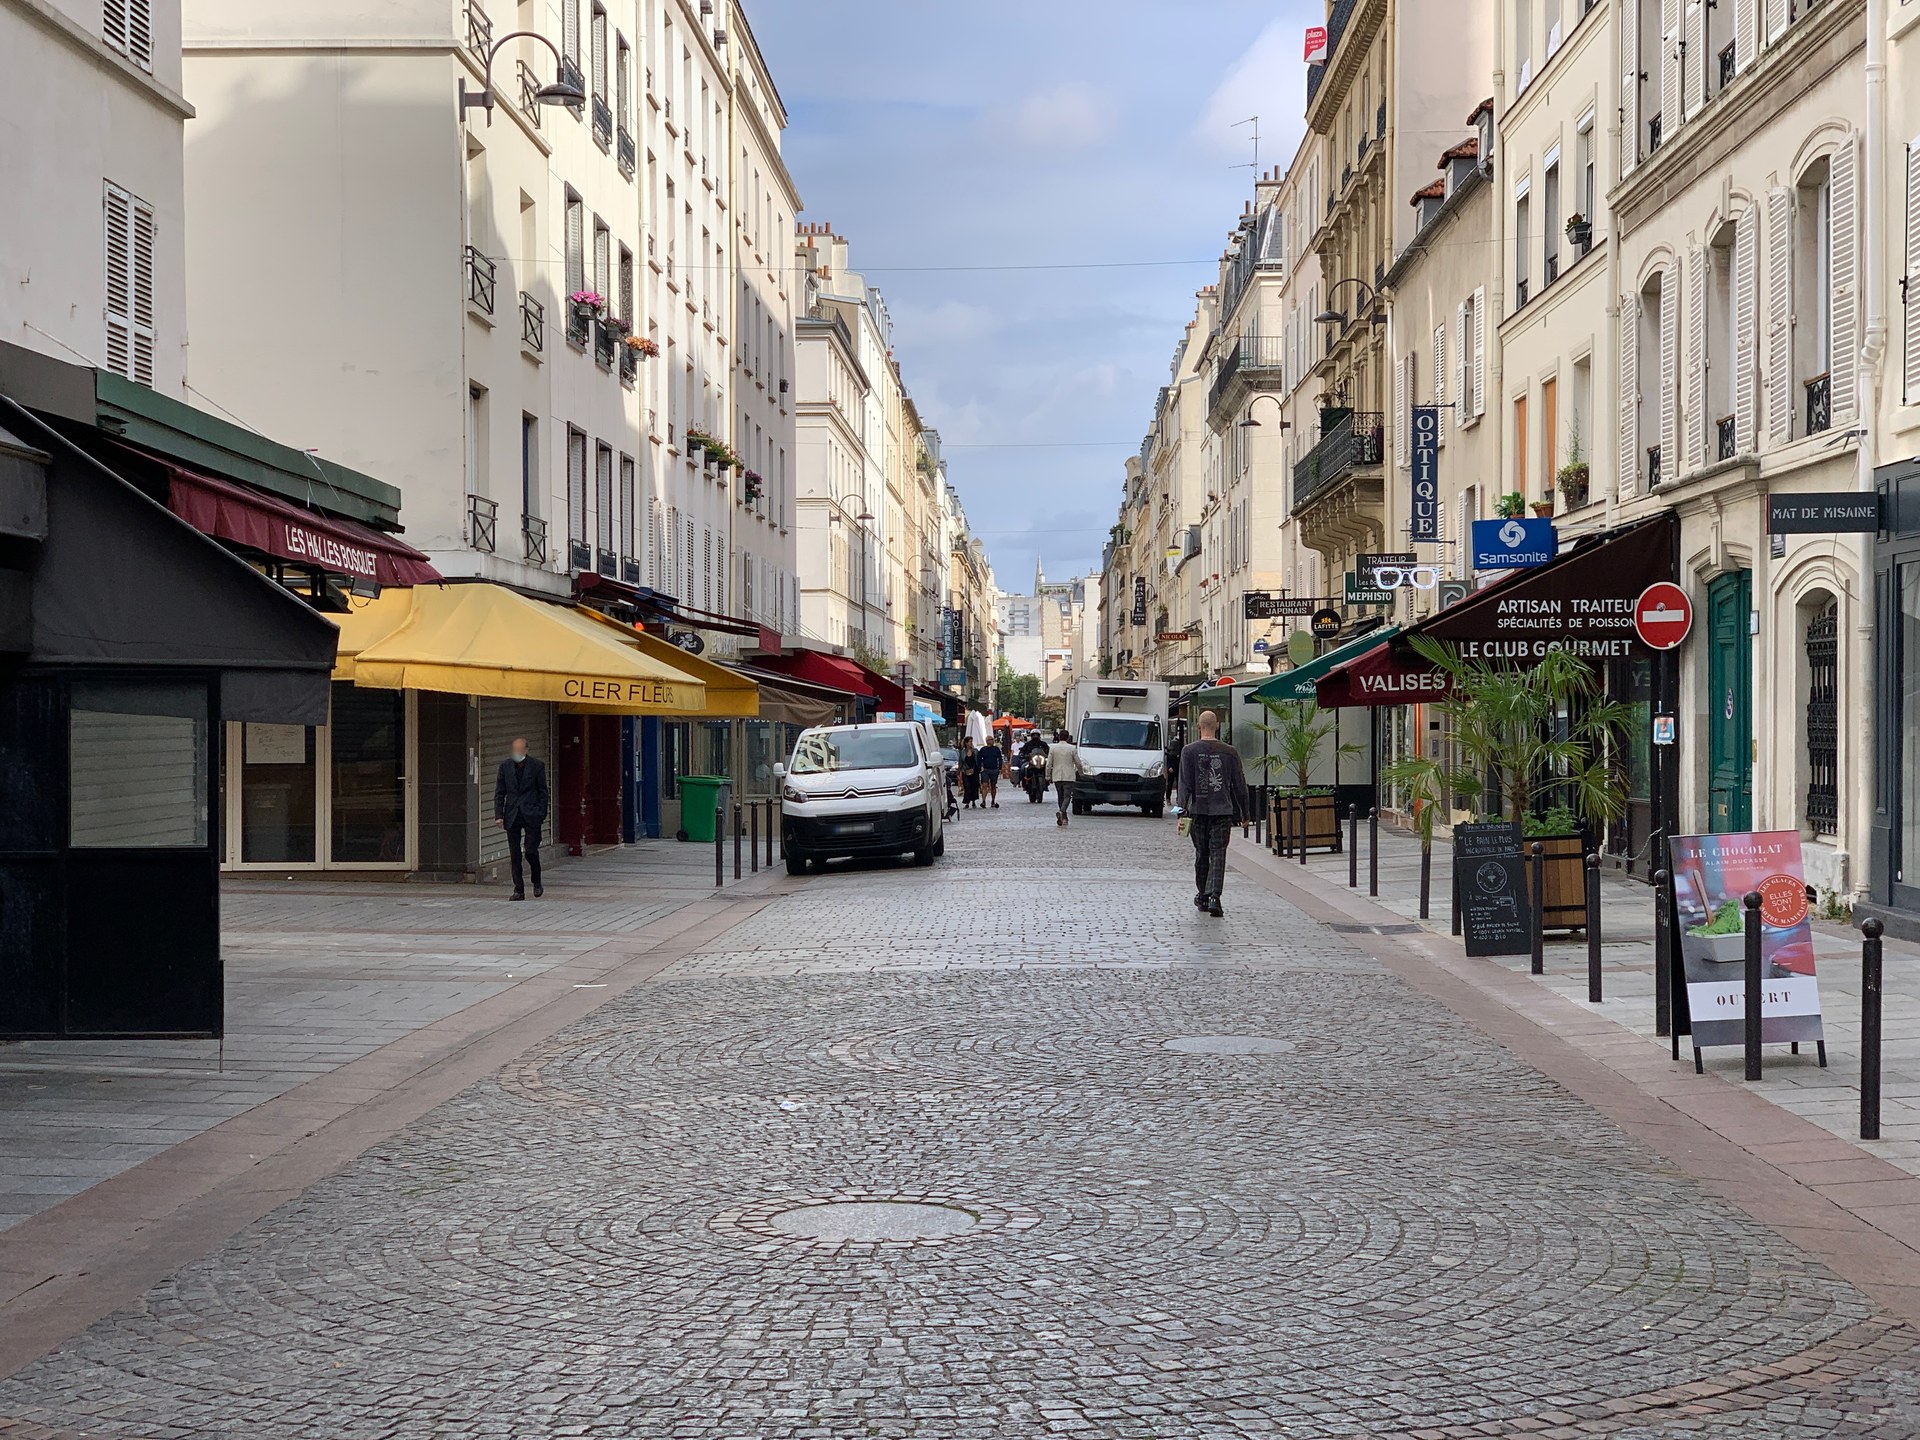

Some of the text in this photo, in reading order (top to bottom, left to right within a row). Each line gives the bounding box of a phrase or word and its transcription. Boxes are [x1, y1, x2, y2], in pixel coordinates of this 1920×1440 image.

[1416, 413, 1434, 536] OPTIQUE
[1772, 506, 1876, 520] MAT DE MISAINE
[285, 524, 377, 575] LES HALLES BOSQUET
[1478, 549, 1549, 565] Samsonite
[1347, 591, 1392, 601] MEPHISTO
[1259, 600, 1313, 608] RESTAURANT
[1266, 607, 1307, 615] JAPONAIS
[1497, 600, 1562, 614] ARTISAN
[1497, 615, 1562, 629] SPÉCIALITÉS
[1568, 618, 1583, 628] DE
[1461, 640, 1633, 659] LE CLUB GOURMET
[1359, 673, 1446, 692] VALISES
[564, 679, 674, 703] CLER FLEURS
[1690, 844, 1783, 858] LE CHOCOLAT
[1760, 878, 1797, 893] LES GLACES
[1769, 890, 1793, 900] ELLES
[1771, 897, 1793, 907] SONT
[1761, 906, 1779, 923] NOTRE
[1716, 991, 1791, 1006] OURT
